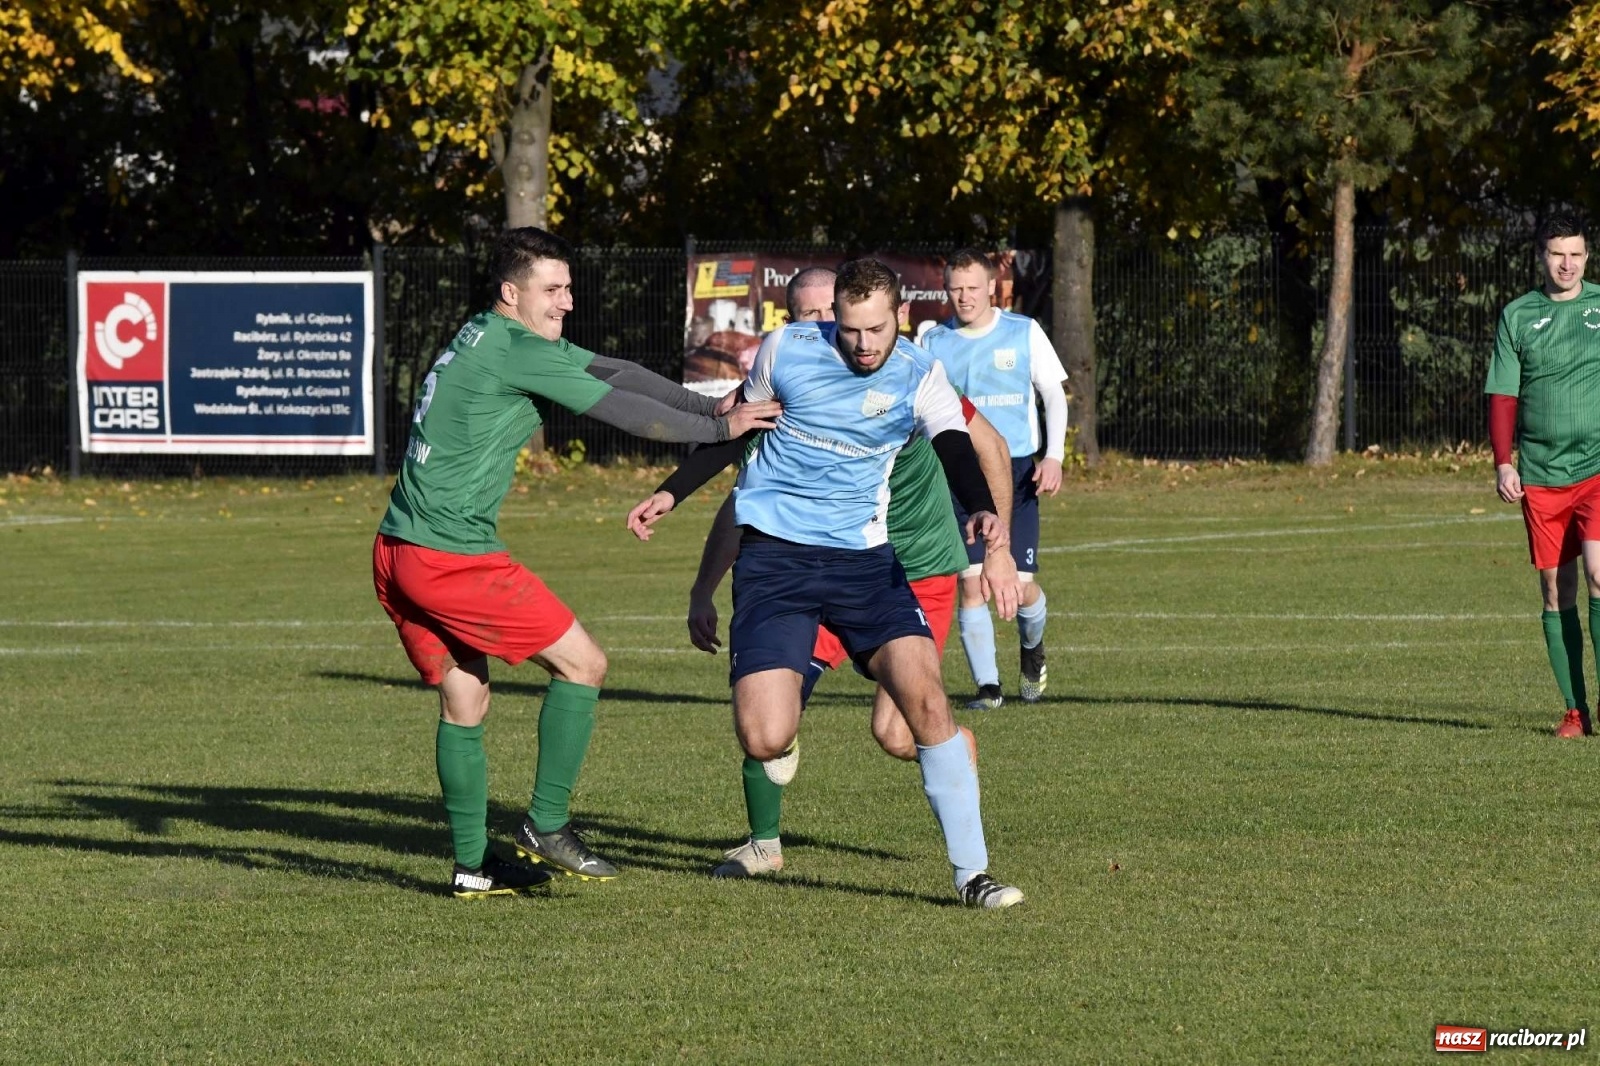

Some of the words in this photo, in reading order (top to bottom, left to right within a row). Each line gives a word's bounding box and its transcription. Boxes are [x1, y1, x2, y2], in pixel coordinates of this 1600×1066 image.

[256, 313, 292, 326] Rybnik,
[294, 313, 306, 324] ul.
[308, 313, 344, 326] Gajowa
[345, 314, 352, 324] 4
[234, 330, 279, 343] Racibórz,
[280, 331, 292, 342] ul.
[294, 332, 338, 344] Rybnicka
[339, 332, 352, 342] 42
[257, 347, 282, 363] Żory,
[284, 350, 295, 360] ul.
[297, 350, 337, 362] Okrężna
[338, 350, 351, 360] 9a
[272, 368, 284, 378] ul.
[286, 368, 296, 378] R.
[297, 368, 342, 379] Ranoszka
[343, 368, 350, 378] 4
[92, 386, 159, 408] INTER
[236, 385, 292, 399] Rydułtowy,
[292, 386, 304, 396] ul.
[306, 386, 341, 398] Gajowa
[342, 386, 350, 396] 11
[194, 403, 247, 414] Wodzisław
[264, 404, 275, 414] ul.
[277, 404, 330, 417] Kokoszycka
[332, 404, 350, 415] 131c
[94, 408, 160, 429] CARS
[1026, 548, 1034, 565] 3
